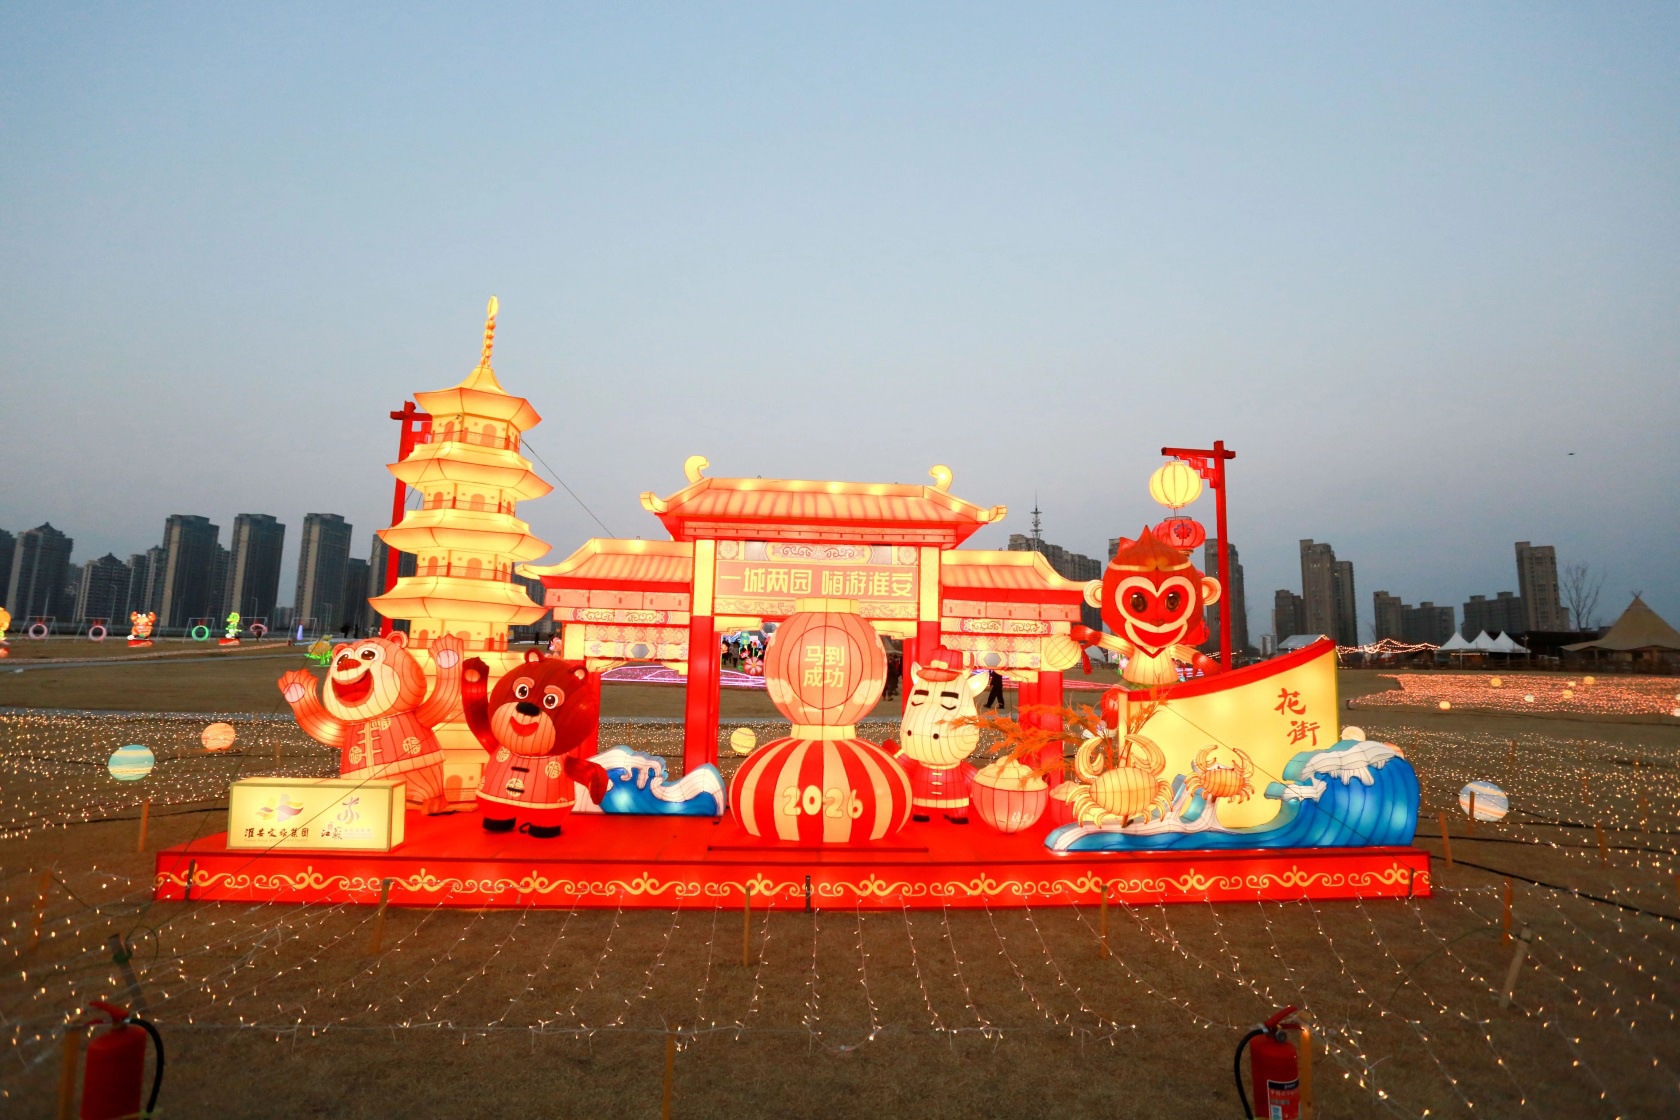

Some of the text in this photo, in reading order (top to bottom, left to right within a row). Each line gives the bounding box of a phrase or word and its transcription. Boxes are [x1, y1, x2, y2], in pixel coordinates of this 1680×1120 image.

[720, 568, 913, 597] 一城两园 嗨游淮安
[804, 645, 845, 666] 马到
[803, 667, 844, 688] 成功
[783, 785, 863, 819] 2026
